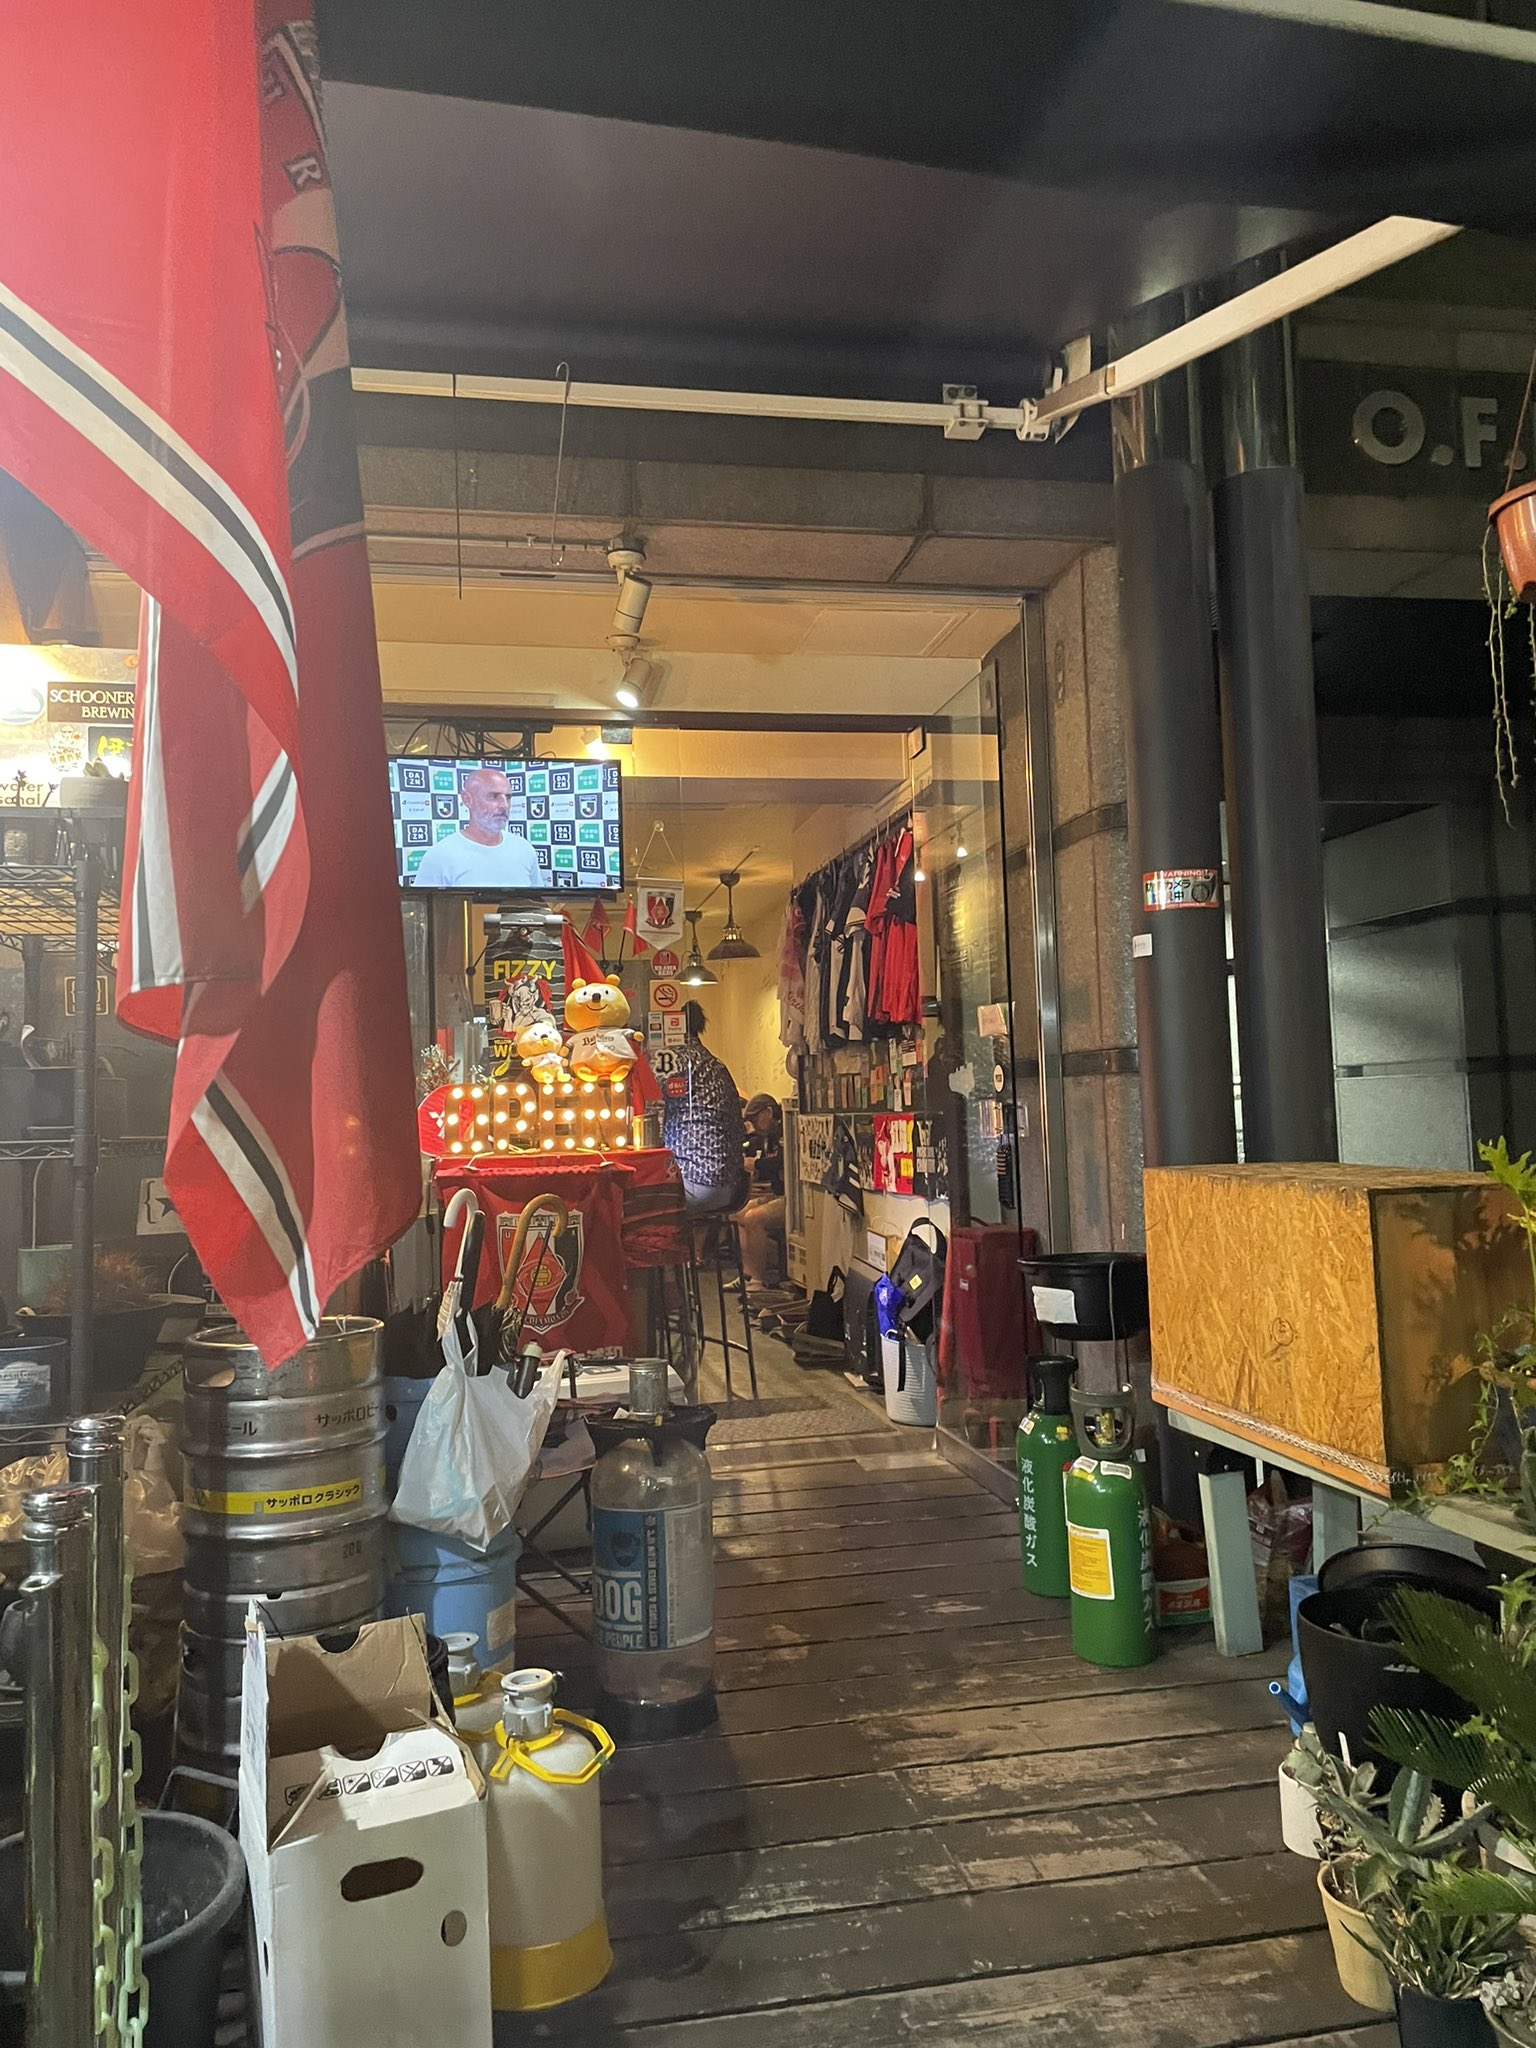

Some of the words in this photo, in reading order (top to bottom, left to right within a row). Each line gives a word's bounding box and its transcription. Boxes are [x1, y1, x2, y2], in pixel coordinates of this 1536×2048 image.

[1352, 389, 1536, 470] O.F.
[49, 689, 135, 705] SCHOONER
[493, 960, 557, 980] FIZZY
[444, 1082, 627, 1156] OPEN
[266, 1484, 361, 1509] サッポロクラシック
[1020, 1458, 1038, 1567] 液化炭酸ガス
